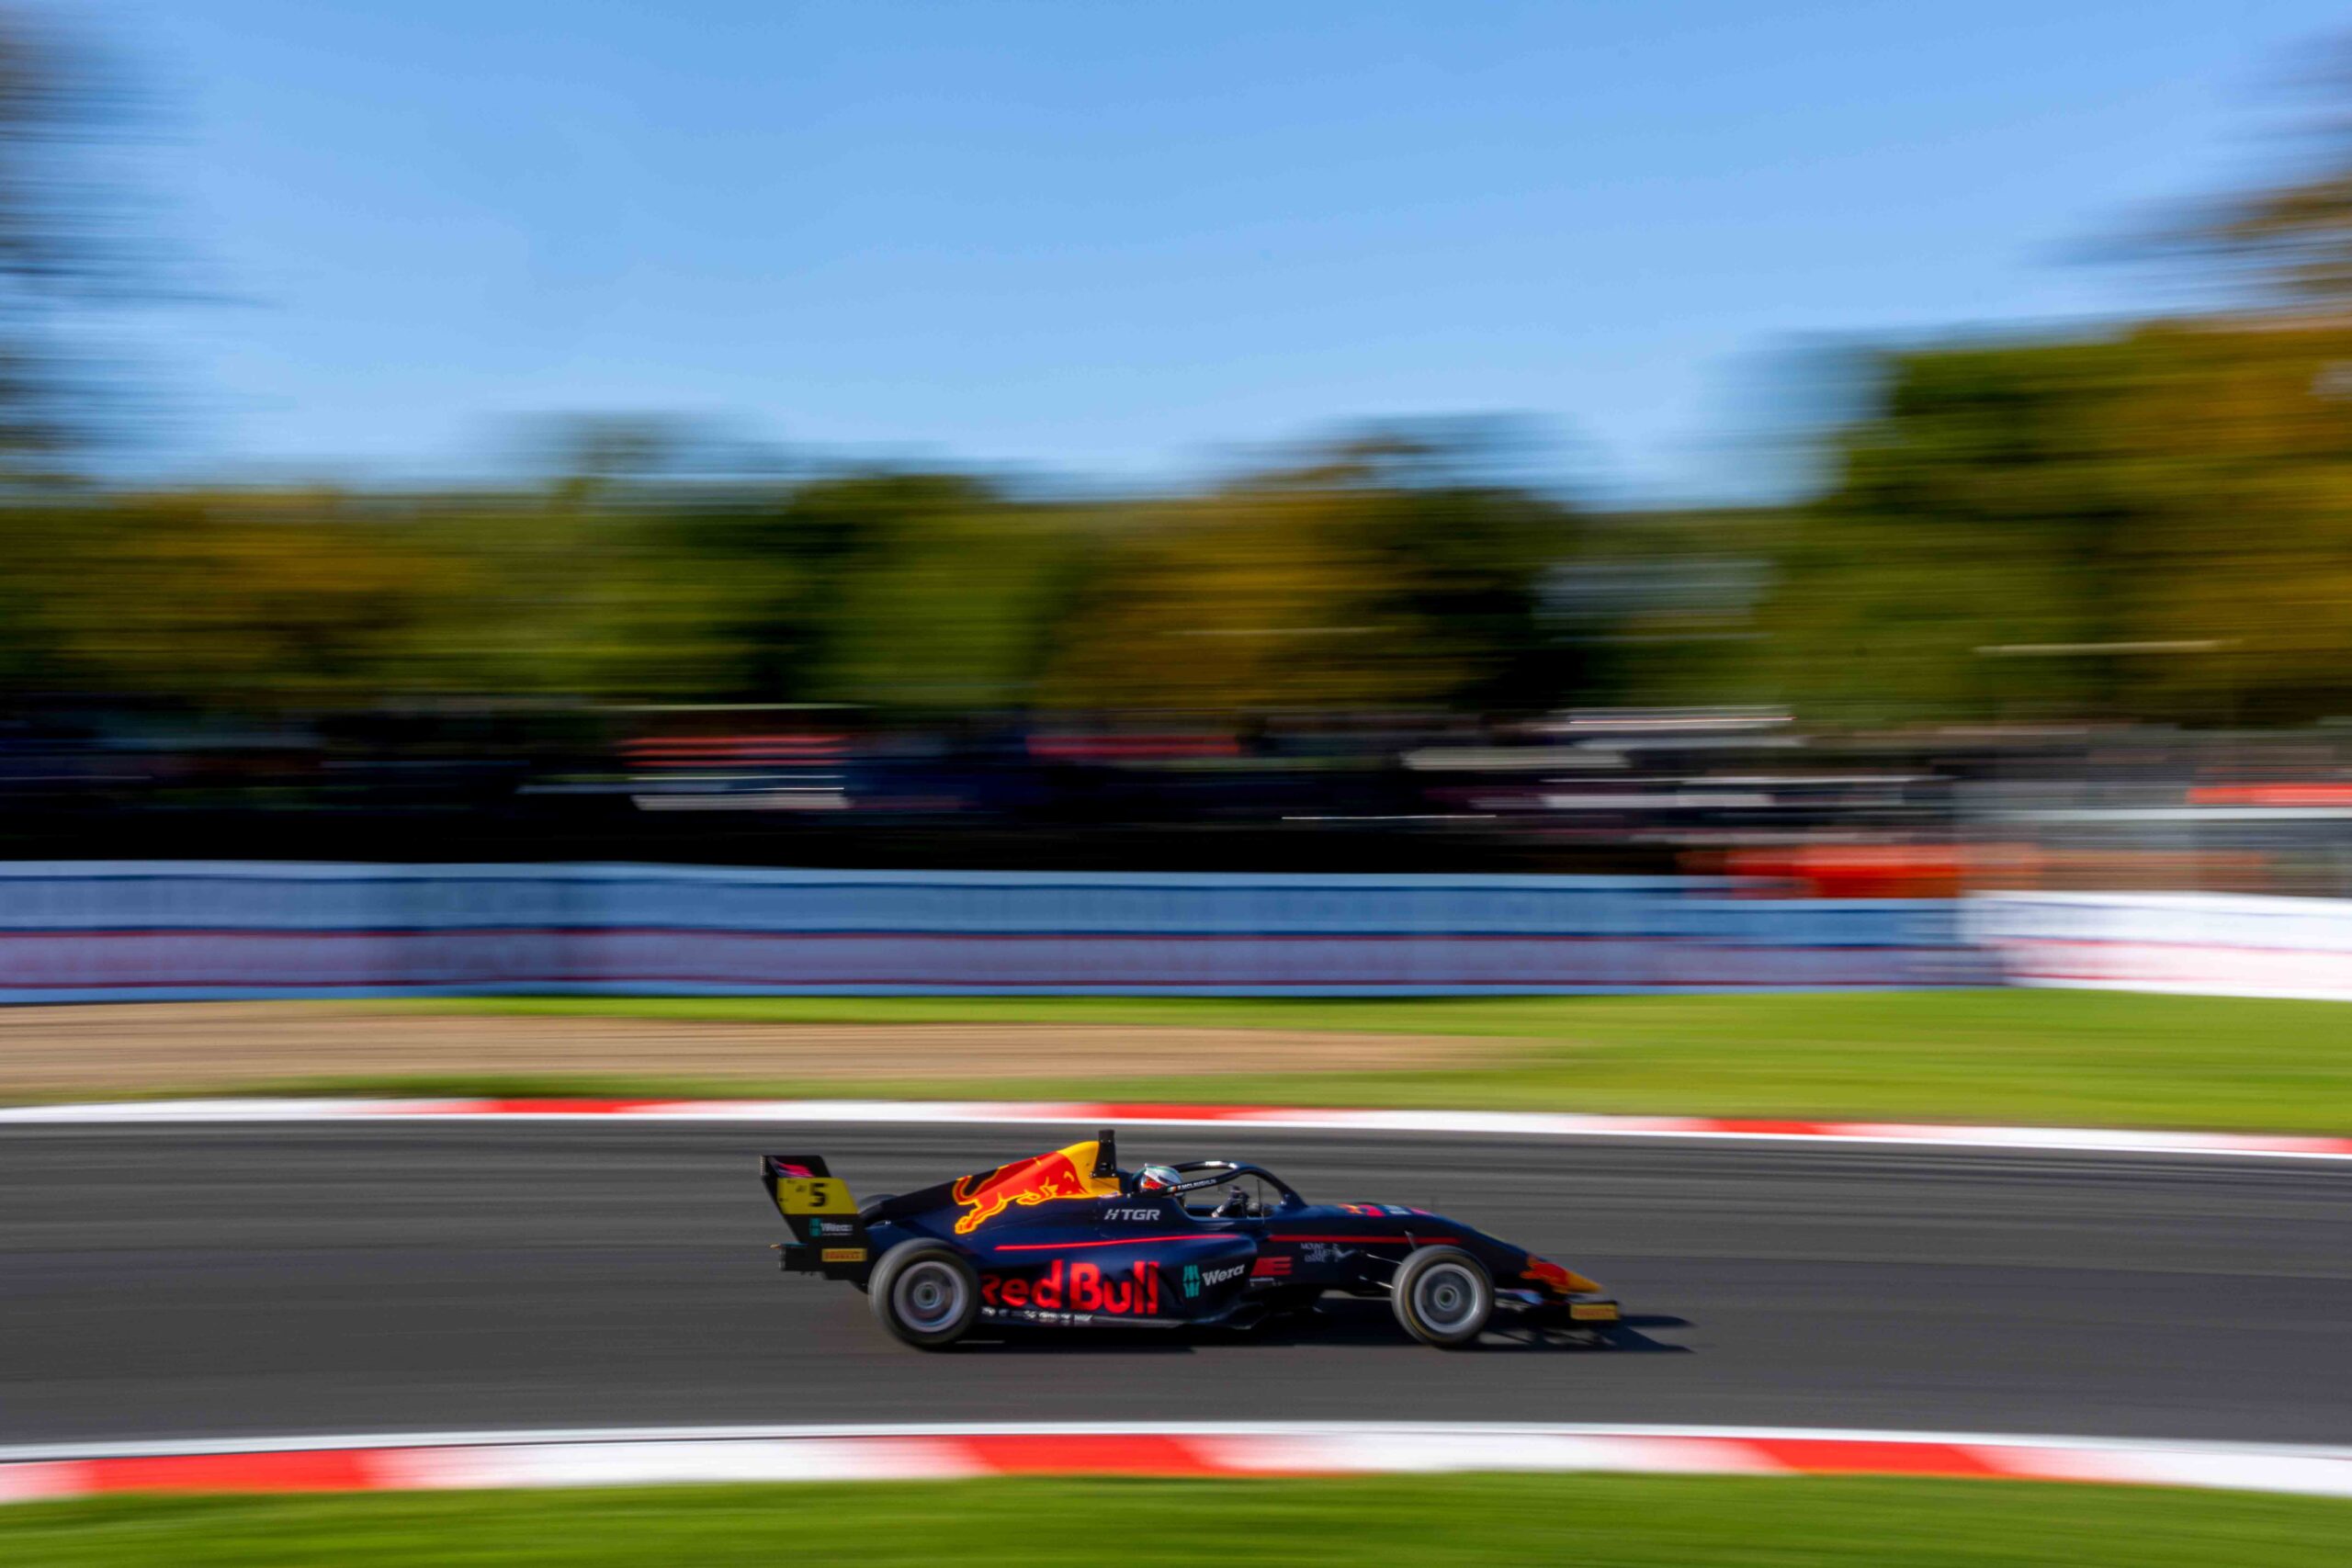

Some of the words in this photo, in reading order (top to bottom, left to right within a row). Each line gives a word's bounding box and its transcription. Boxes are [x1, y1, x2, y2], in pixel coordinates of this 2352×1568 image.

[809, 1182, 827, 1207] 5
[980, 1259, 1063, 1308] Red
[1069, 1261, 1159, 1314] Bull
[1203, 1264, 1245, 1286] Wera
